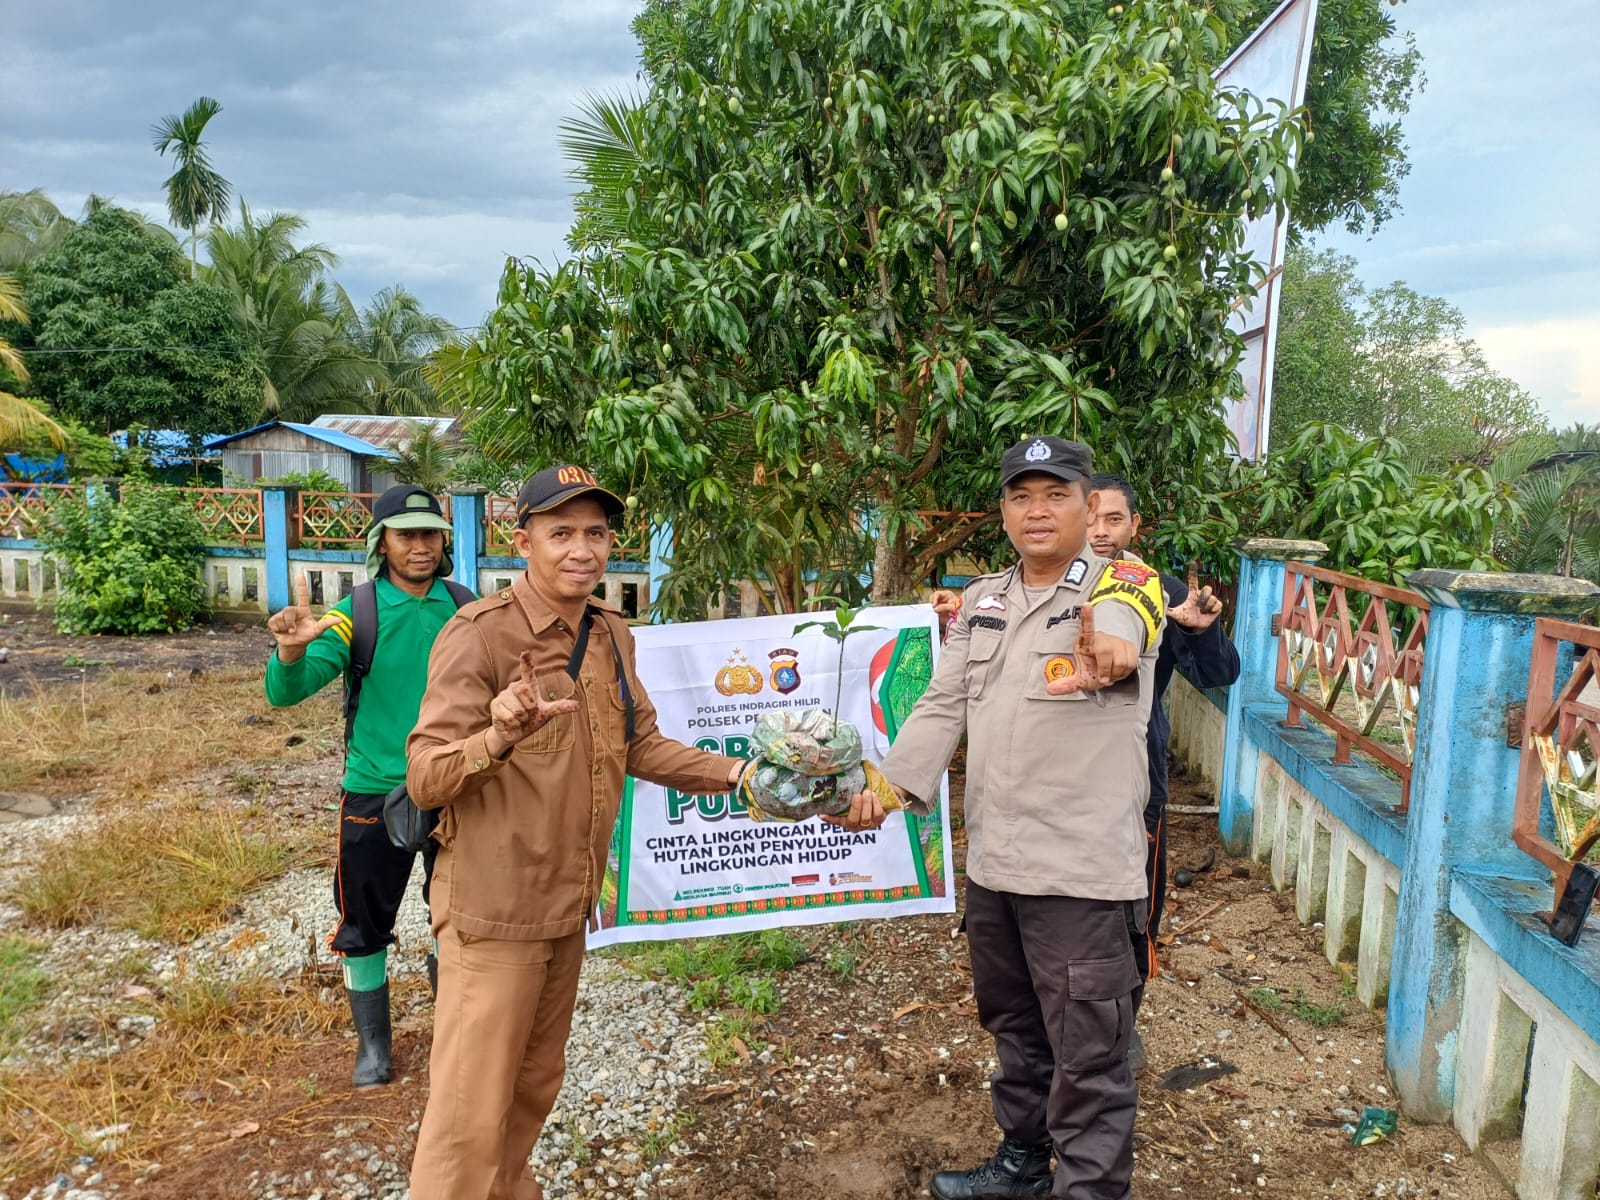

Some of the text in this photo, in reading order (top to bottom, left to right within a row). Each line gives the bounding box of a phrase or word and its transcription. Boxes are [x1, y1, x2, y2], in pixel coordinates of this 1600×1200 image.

[697, 697, 821, 714] POLRES INDRAGIRI HILIR
[687, 715, 741, 729] POLSEK
[646, 834, 698, 849] CINTA
[702, 823, 815, 845] LINGKUNGAN
[654, 833, 877, 863] HUTAN DAN PENYULUHAN
[680, 848, 852, 875] LINGKUNGAN HIDUP
